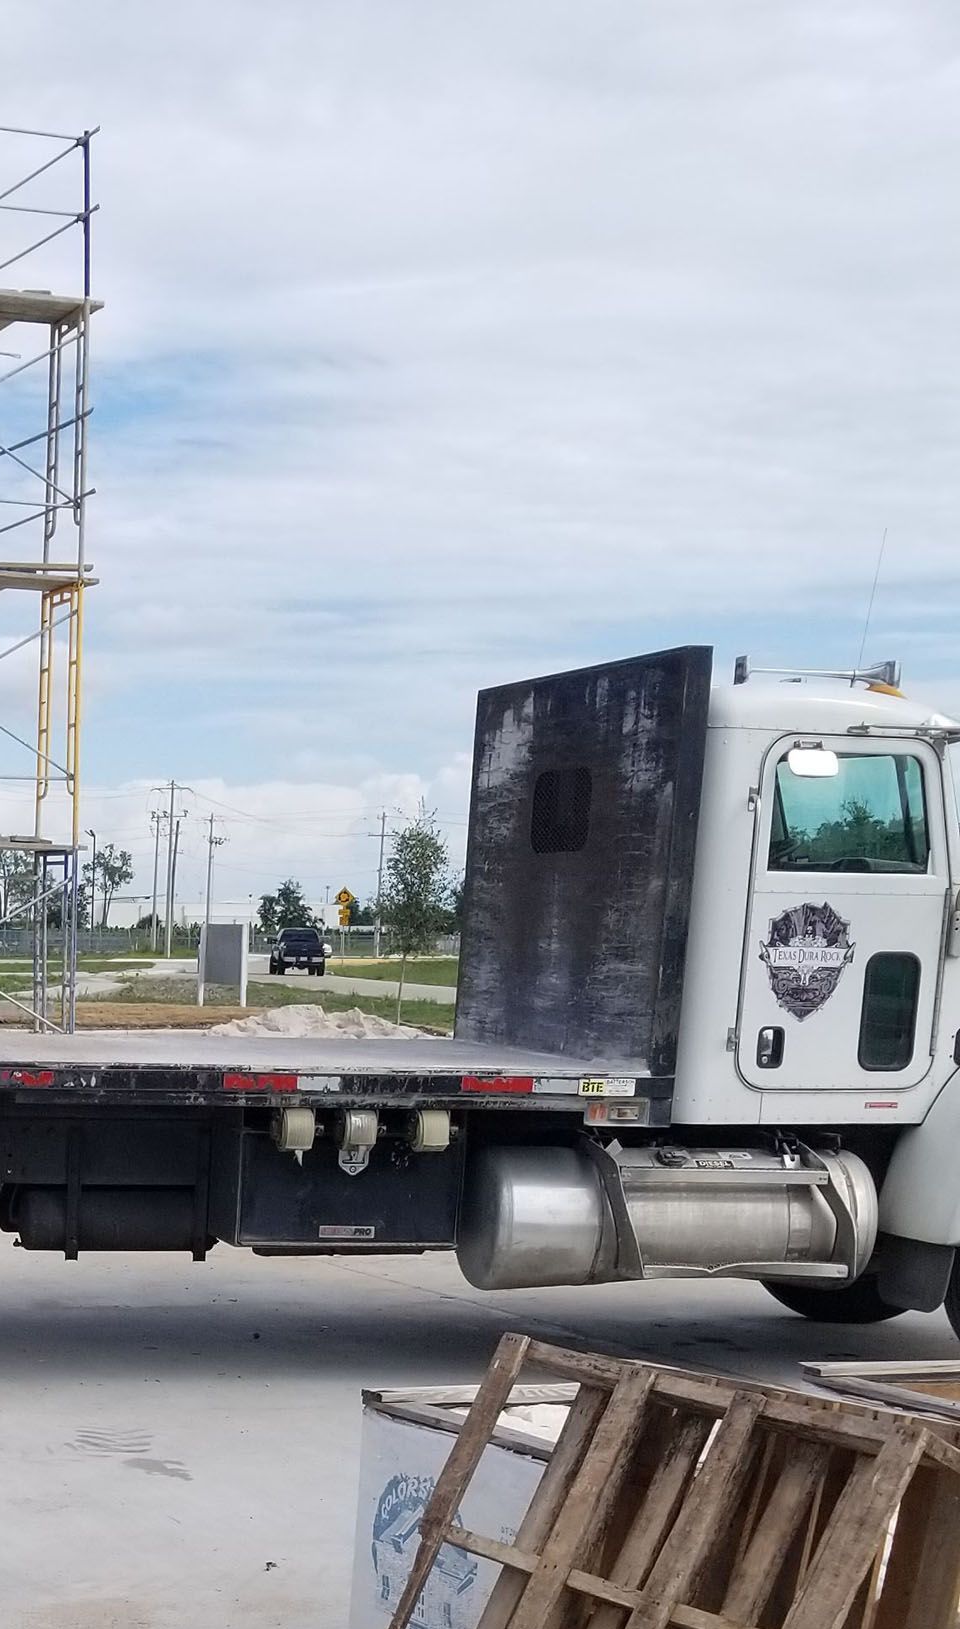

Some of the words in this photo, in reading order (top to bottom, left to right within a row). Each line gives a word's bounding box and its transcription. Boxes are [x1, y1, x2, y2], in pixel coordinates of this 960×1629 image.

[772, 948, 797, 963] TEXAS
[798, 948, 819, 964] DURA
[820, 949, 841, 963] ROCK
[582, 1081, 604, 1093] BTE
[698, 1159, 732, 1167] DIESEL
